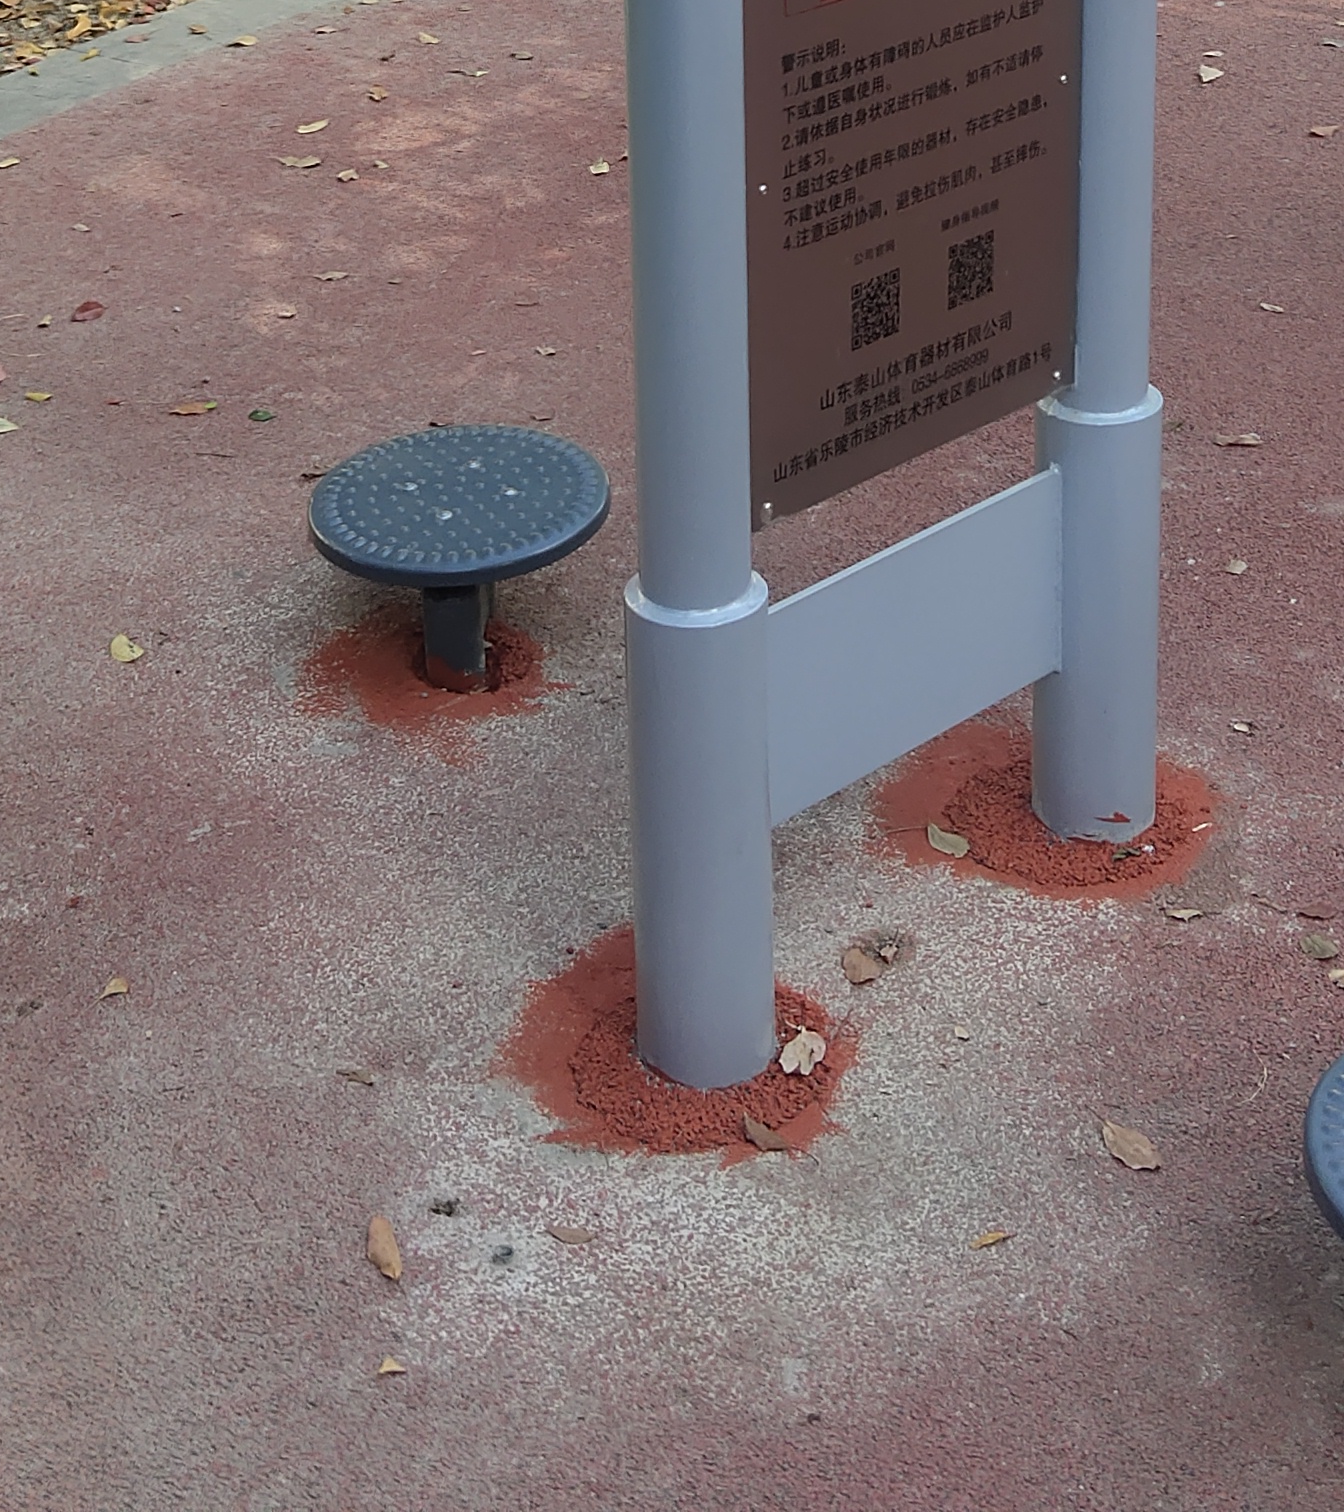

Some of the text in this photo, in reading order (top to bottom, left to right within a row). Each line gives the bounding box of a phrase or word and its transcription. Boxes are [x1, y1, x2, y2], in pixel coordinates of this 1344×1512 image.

[780, 38, 846, 74] 警示说明：
[820, 311, 1013, 411] 山东泰山体育器材有限公司
[843, 385, 901, 427] 服务热线
